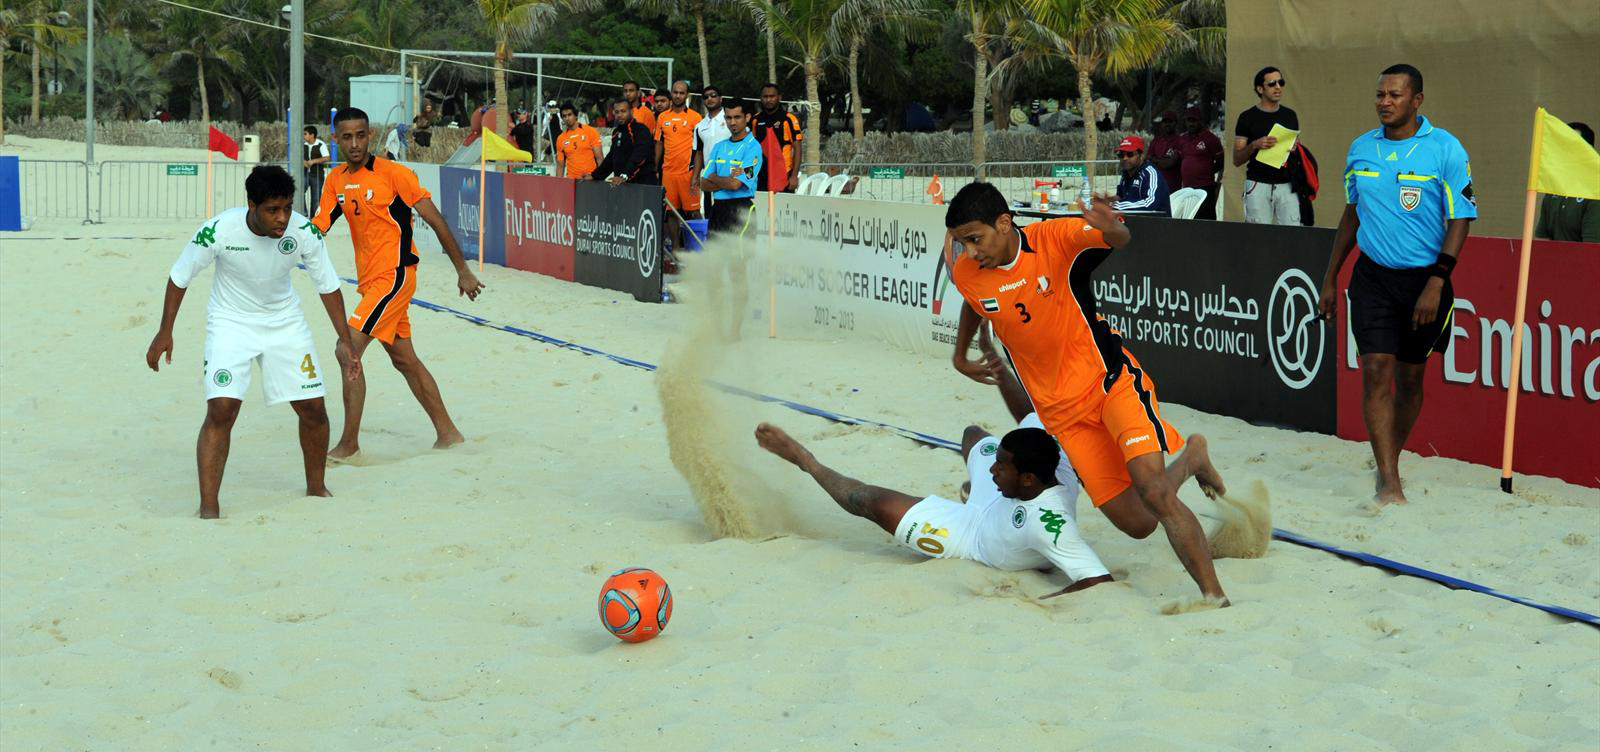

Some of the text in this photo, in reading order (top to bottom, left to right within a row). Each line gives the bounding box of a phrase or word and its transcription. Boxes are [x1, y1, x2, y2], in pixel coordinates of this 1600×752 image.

[351, 199, 361, 216] 2
[505, 198, 574, 247] Fly Emirates
[576, 214, 636, 242] مجلس دبي الرياضي
[834, 212, 861, 250] لكرة
[862, 217, 899, 259] الإمارات
[576, 238, 636, 261] DUBAI SPORTS COUNCIL
[901, 227, 927, 269] دوري
[776, 263, 815, 289] BEACH
[817, 268, 870, 299] SOCCER
[873, 275, 928, 309] LEAGUE
[1093, 274, 1260, 326] مجلس دبي الرياضي
[814, 306, 830, 326] 2012
[838, 310, 855, 331] 2013
[1014, 302, 1032, 324] 3
[1136, 317, 1189, 348] SPORTS
[1193, 326, 1260, 359] COUNCIL
[300, 353, 318, 379] 4
